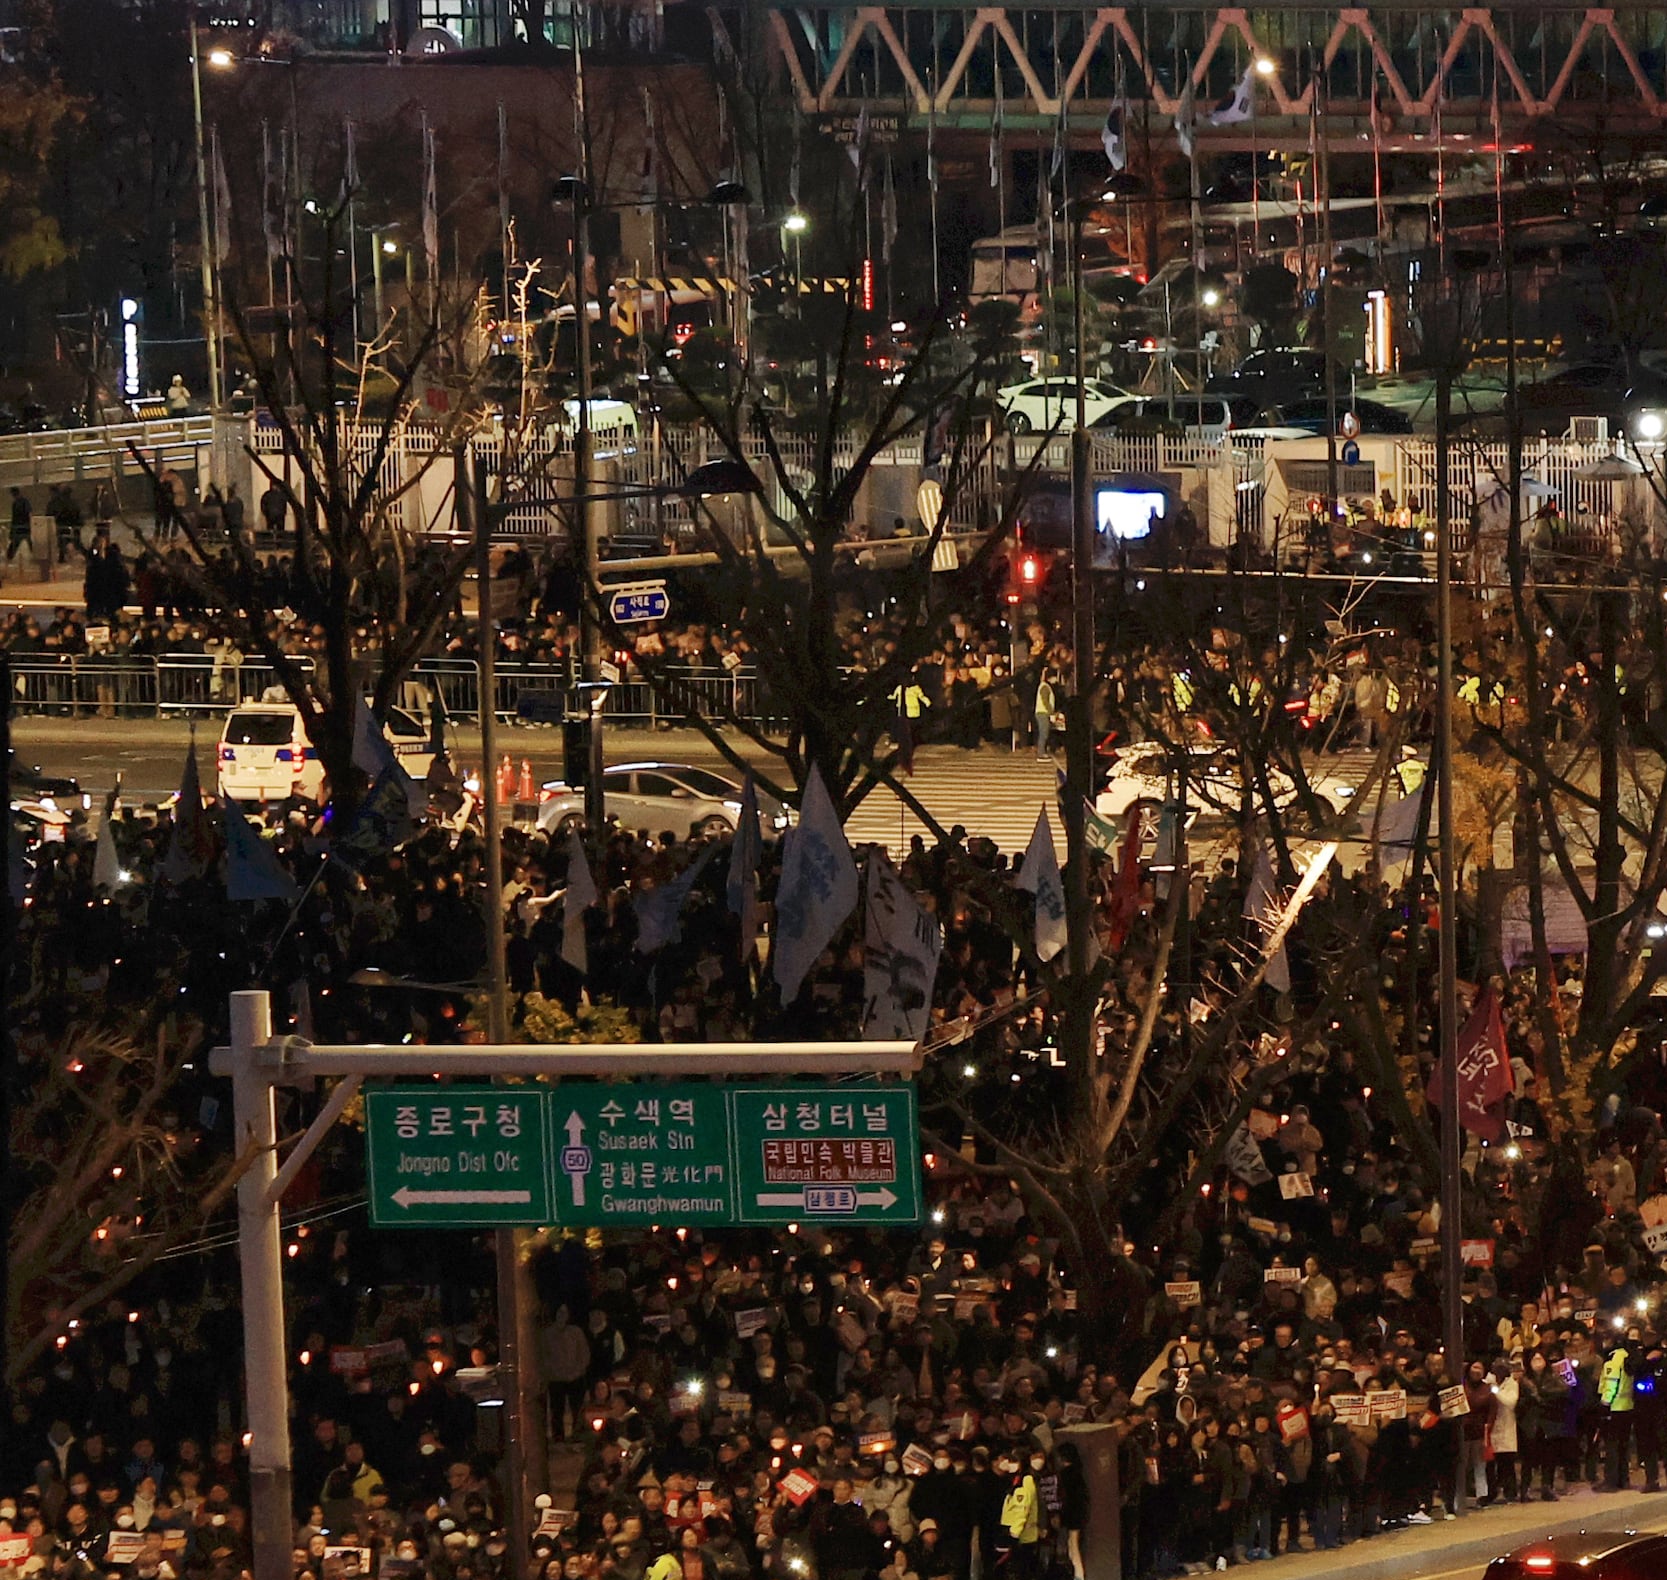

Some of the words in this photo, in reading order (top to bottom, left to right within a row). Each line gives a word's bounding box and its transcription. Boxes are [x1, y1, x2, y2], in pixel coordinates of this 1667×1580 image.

[395, 1104, 520, 1138] 종로구청
[599, 1099, 694, 1126] 수색역
[762, 1103, 888, 1131] 삼청터널
[599, 1130, 658, 1150] Susaek
[668, 1130, 694, 1150] Stn
[397, 1153, 449, 1176] Jongno
[458, 1152, 486, 1172] Dist
[568, 1154, 585, 1167] 50
[767, 1142, 832, 1164] 국립민속
[843, 1142, 891, 1163] 박물관
[601, 1162, 656, 1189] 광화문
[662, 1165, 724, 1184] 光化門
[768, 1166, 814, 1180] National
[820, 1166, 841, 1179] Folk
[848, 1166, 892, 1180] Museum
[602, 1194, 724, 1214] Gwanghwamun
